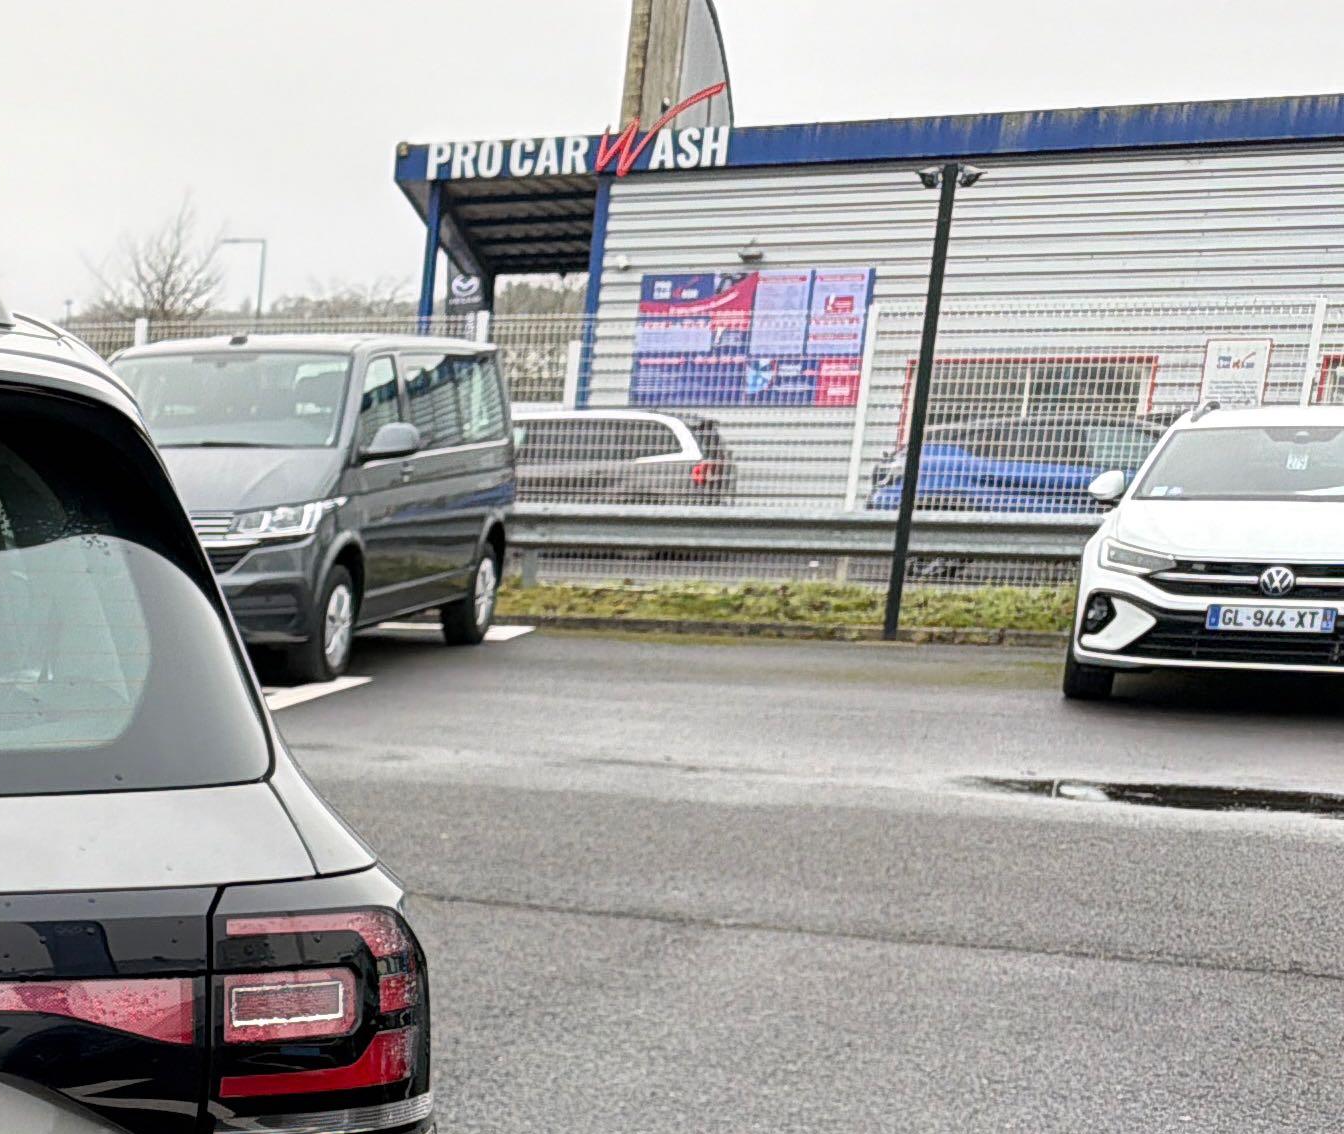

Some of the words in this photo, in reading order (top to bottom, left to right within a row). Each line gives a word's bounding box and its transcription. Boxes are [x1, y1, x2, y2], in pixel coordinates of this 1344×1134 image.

[426, 140, 503, 181] PRO
[509, 135, 588, 178] CAR
[595, 82, 730, 178] WASH
